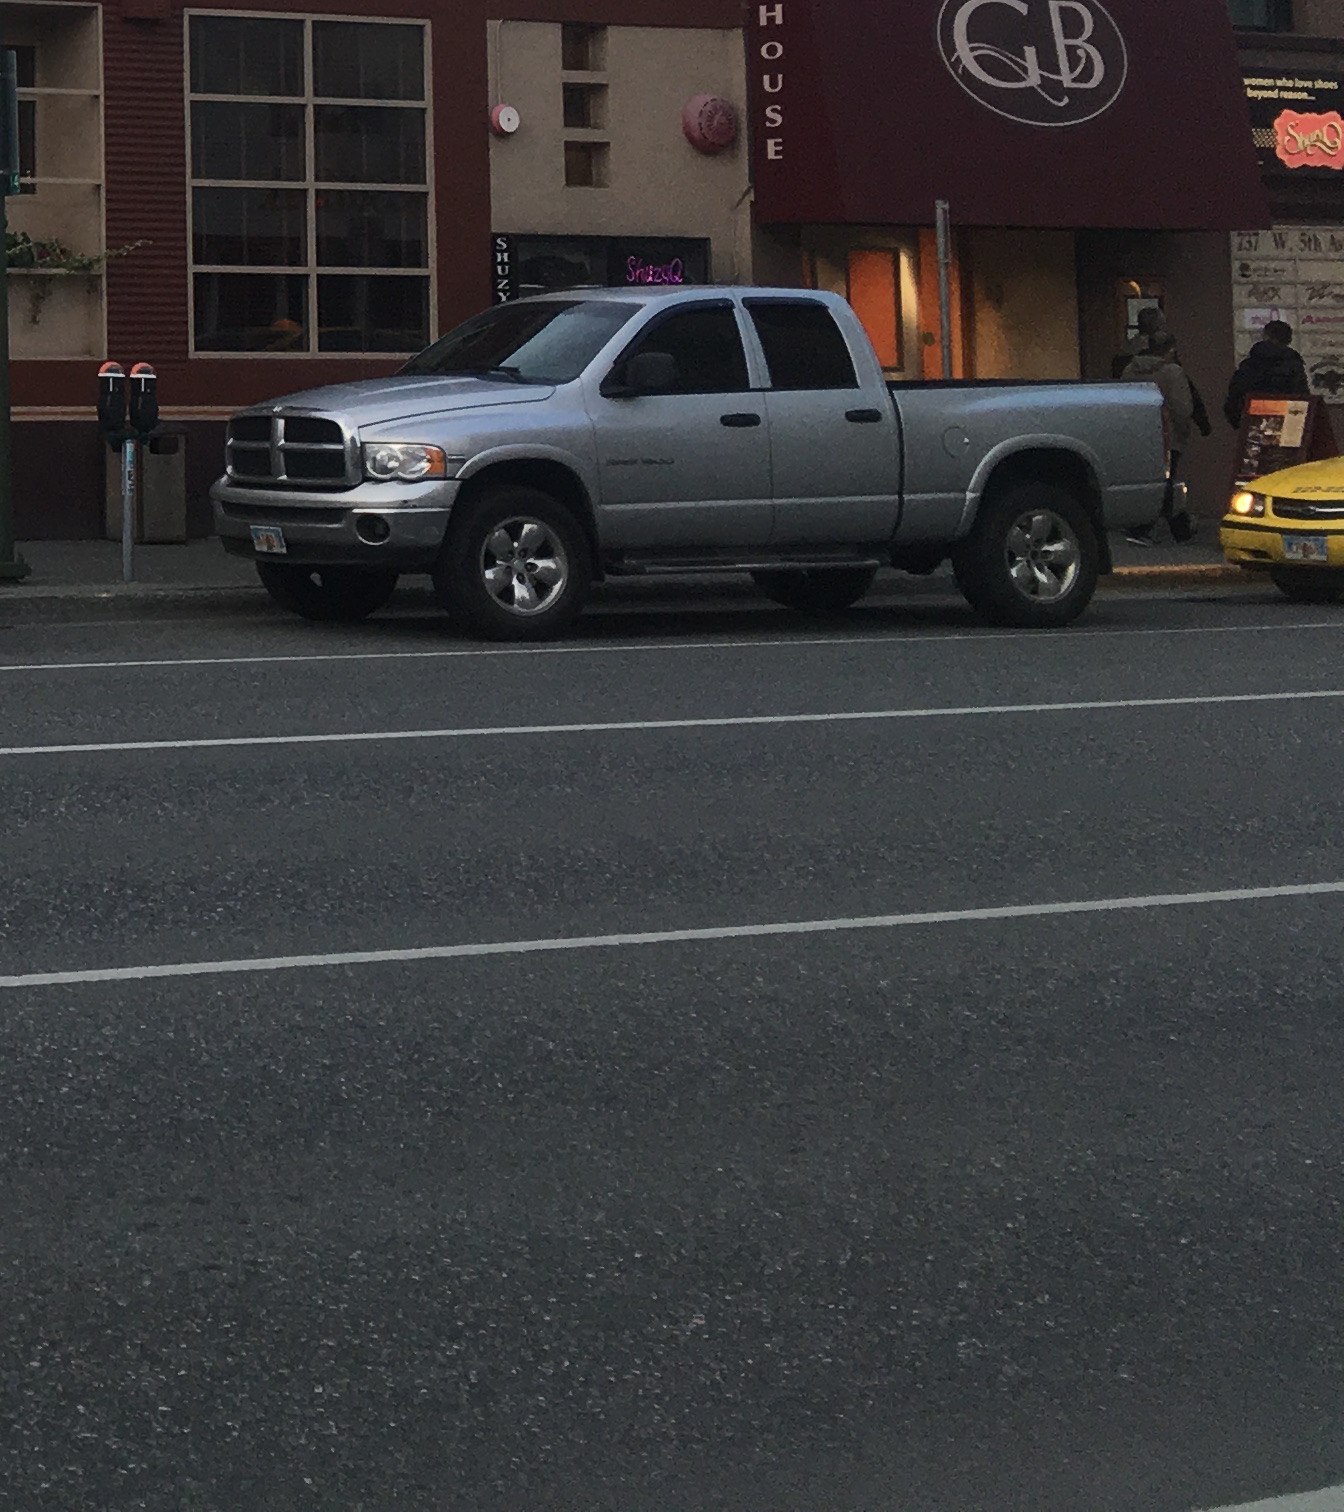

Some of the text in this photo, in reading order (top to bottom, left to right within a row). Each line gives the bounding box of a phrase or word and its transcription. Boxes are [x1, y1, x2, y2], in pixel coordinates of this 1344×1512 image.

[1243, 76, 1339, 89] women who love shoes
[1246, 86, 1279, 100] beyond
[1237, 232, 1260, 252] 737
[1298, 231, 1322, 252] 5th
[495, 237, 511, 302] SHUZY
[625, 255, 684, 285] ShuzyQ
